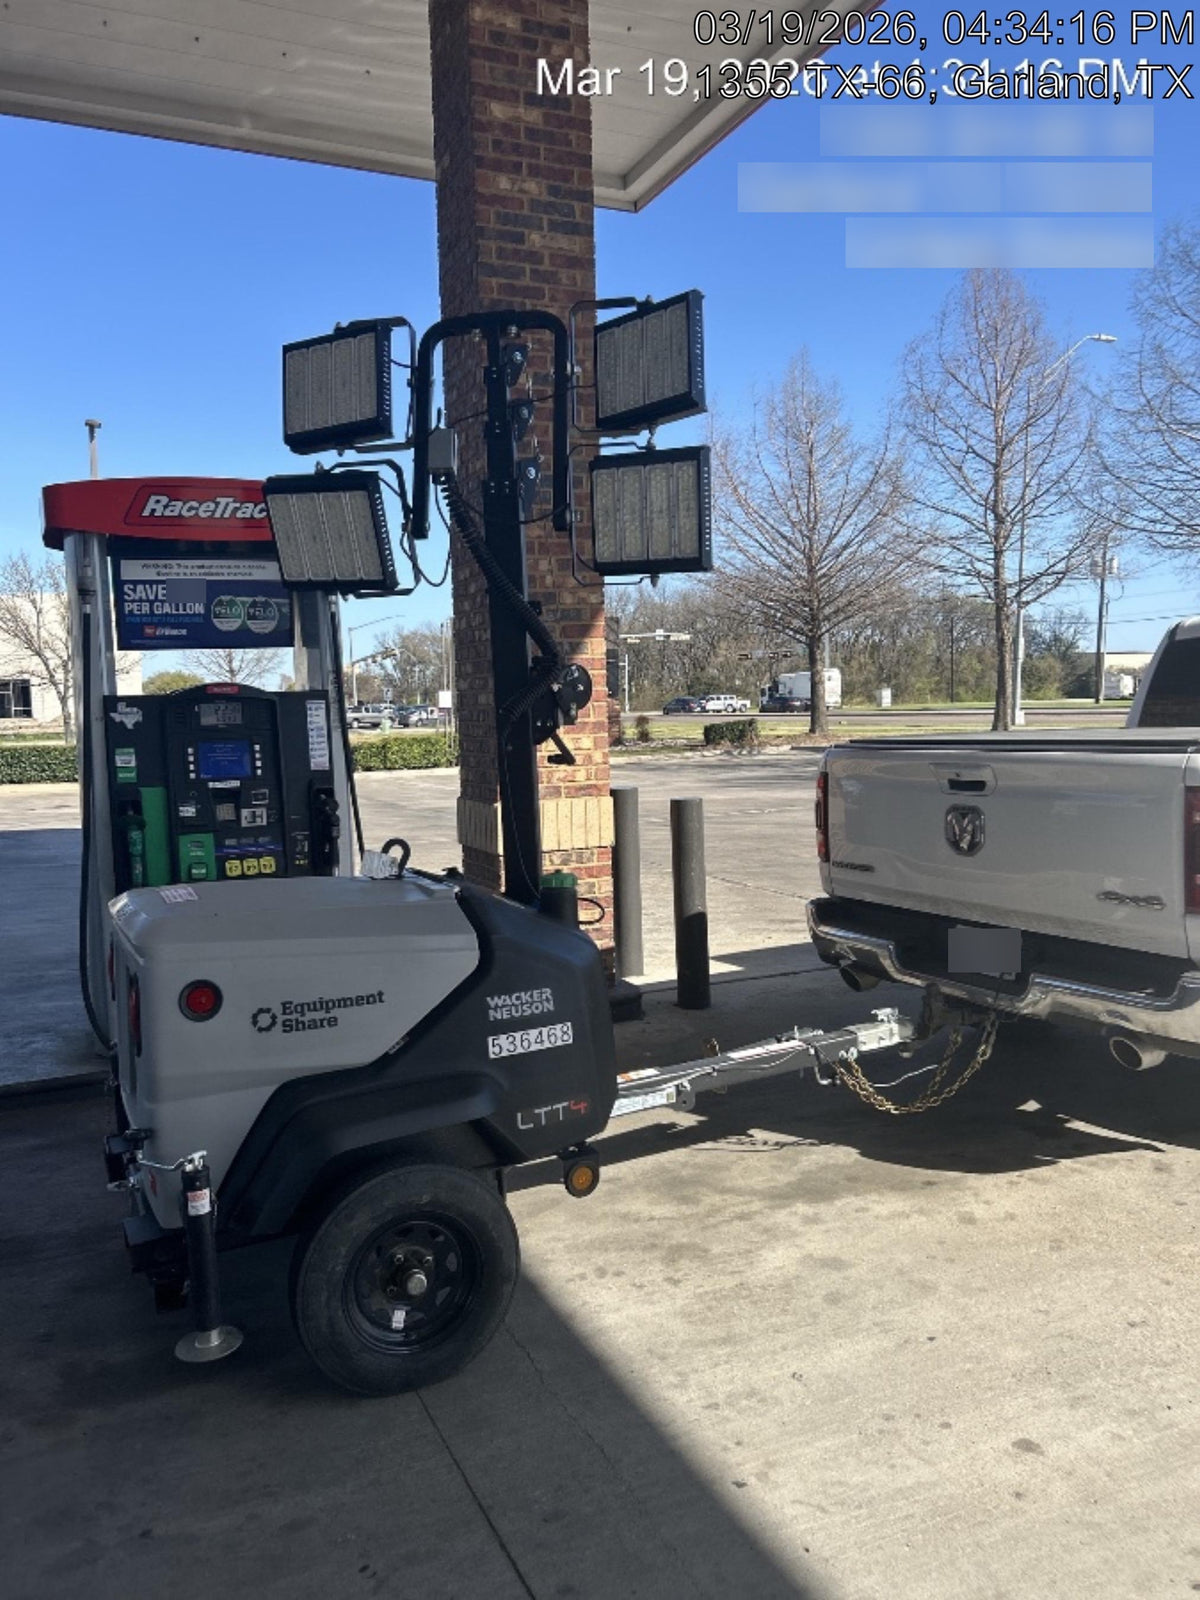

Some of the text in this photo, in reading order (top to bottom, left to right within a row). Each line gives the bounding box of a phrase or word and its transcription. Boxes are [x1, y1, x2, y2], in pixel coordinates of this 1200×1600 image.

[141, 494, 268, 519] RaceTrac
[123, 584, 166, 600] SAVE
[124, 602, 205, 615] PER GALLON
[281, 990, 385, 1017] Equipment
[486, 987, 552, 1009] WACKER
[488, 999, 555, 1021] NEUSON
[281, 1015, 339, 1033] Share
[491, 1023, 572, 1057] 536468
[516, 1100, 588, 1130] LTT4
